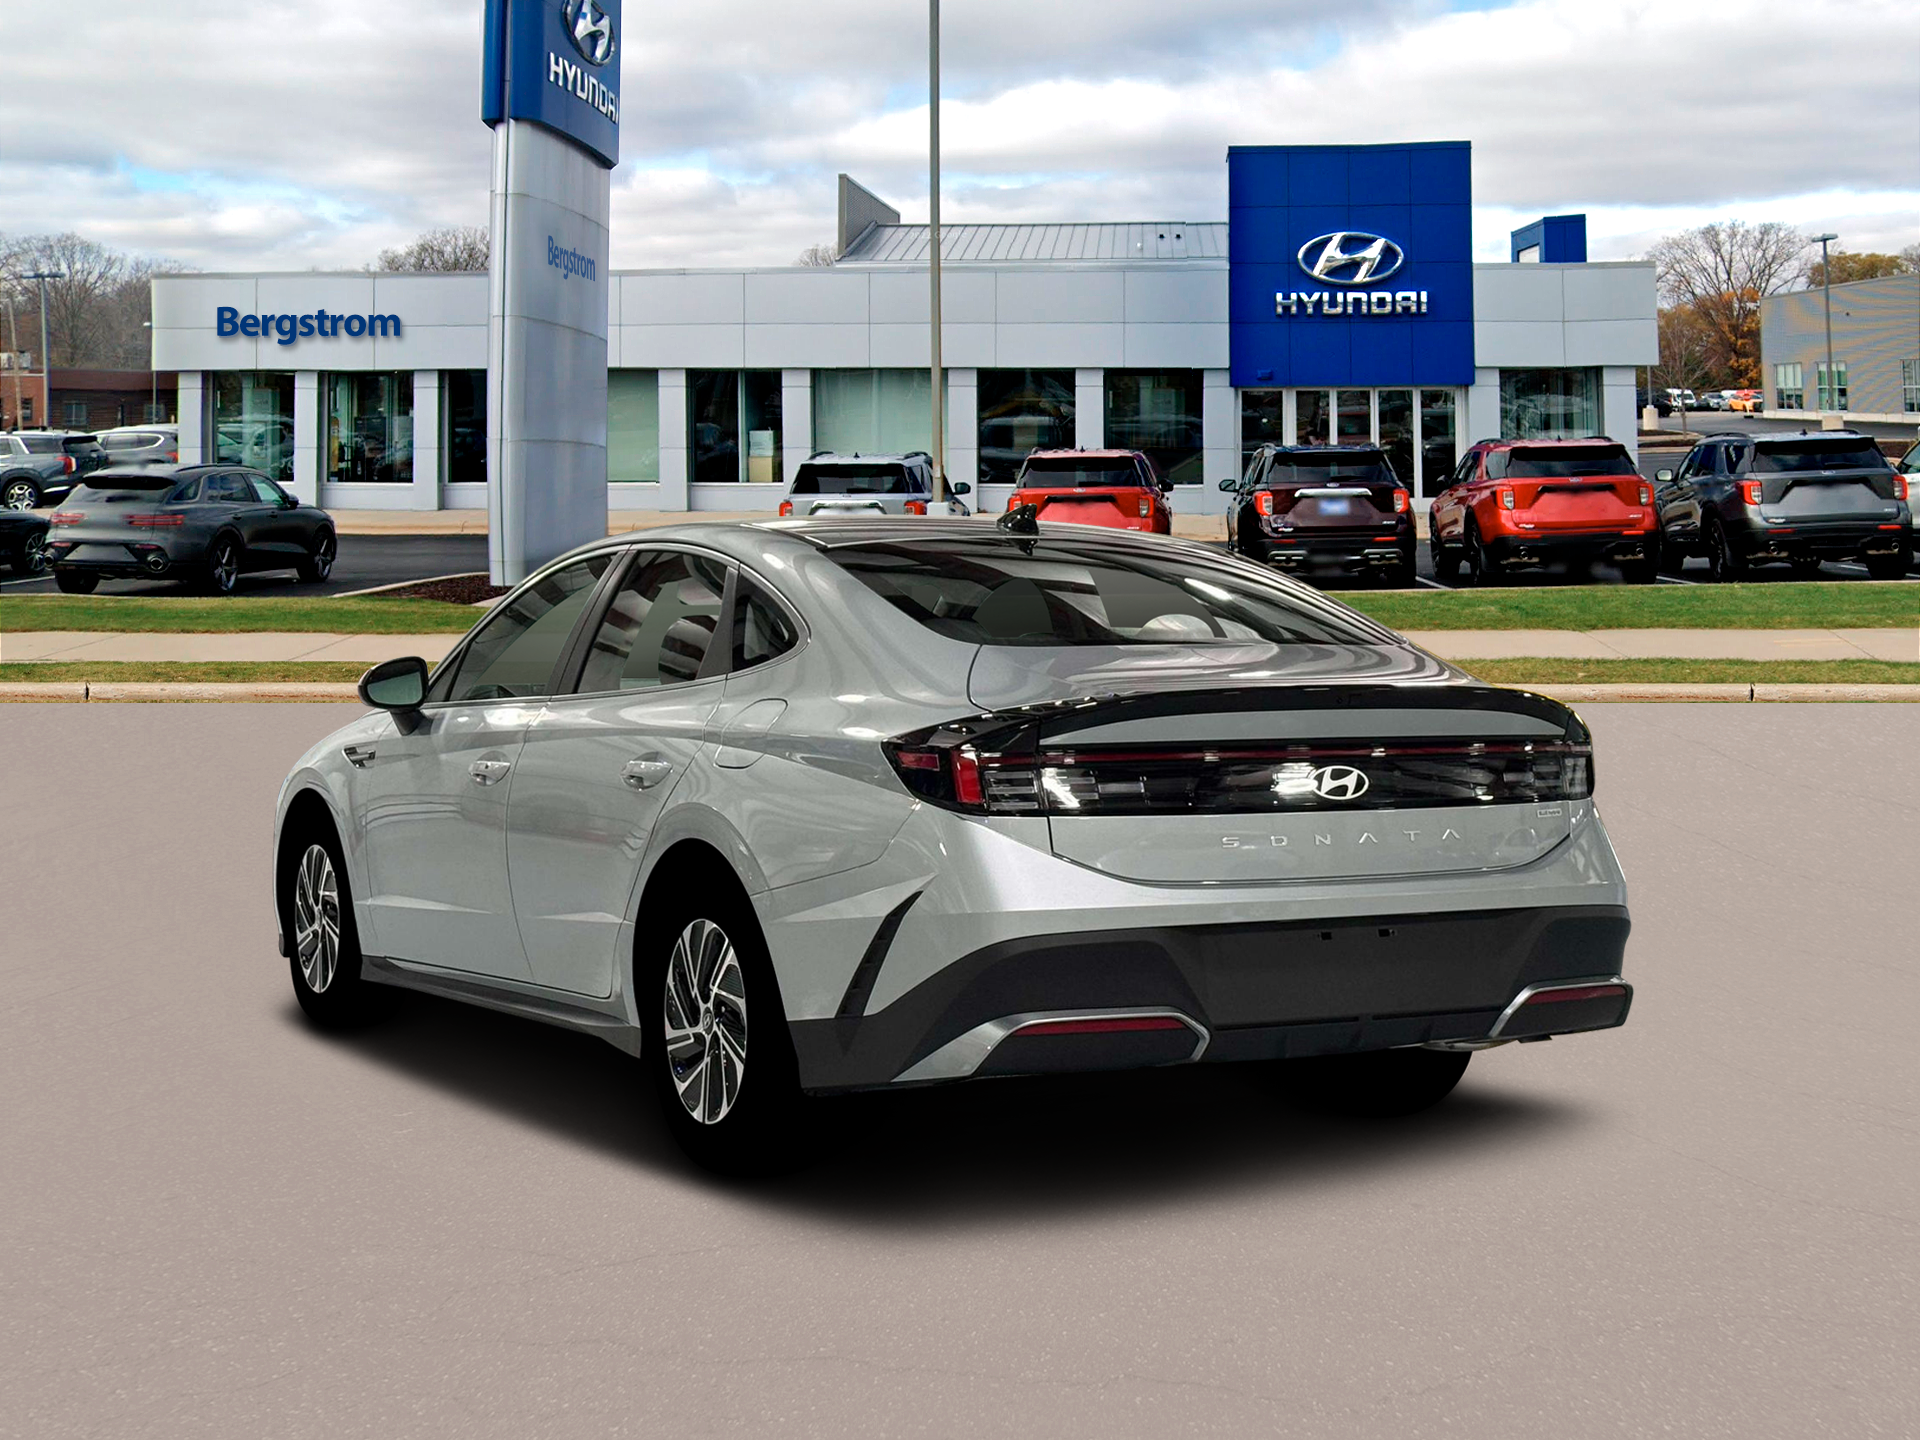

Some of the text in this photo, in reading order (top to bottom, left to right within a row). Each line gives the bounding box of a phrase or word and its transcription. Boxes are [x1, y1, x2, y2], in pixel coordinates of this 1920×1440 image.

[549, 51, 619, 124] HYUNDAI
[547, 235, 596, 282] Bergstrom
[1275, 291, 1428, 316] HYUNDAI
[216, 306, 402, 346] Bergstrom
[1221, 828, 1461, 848] SONATA
